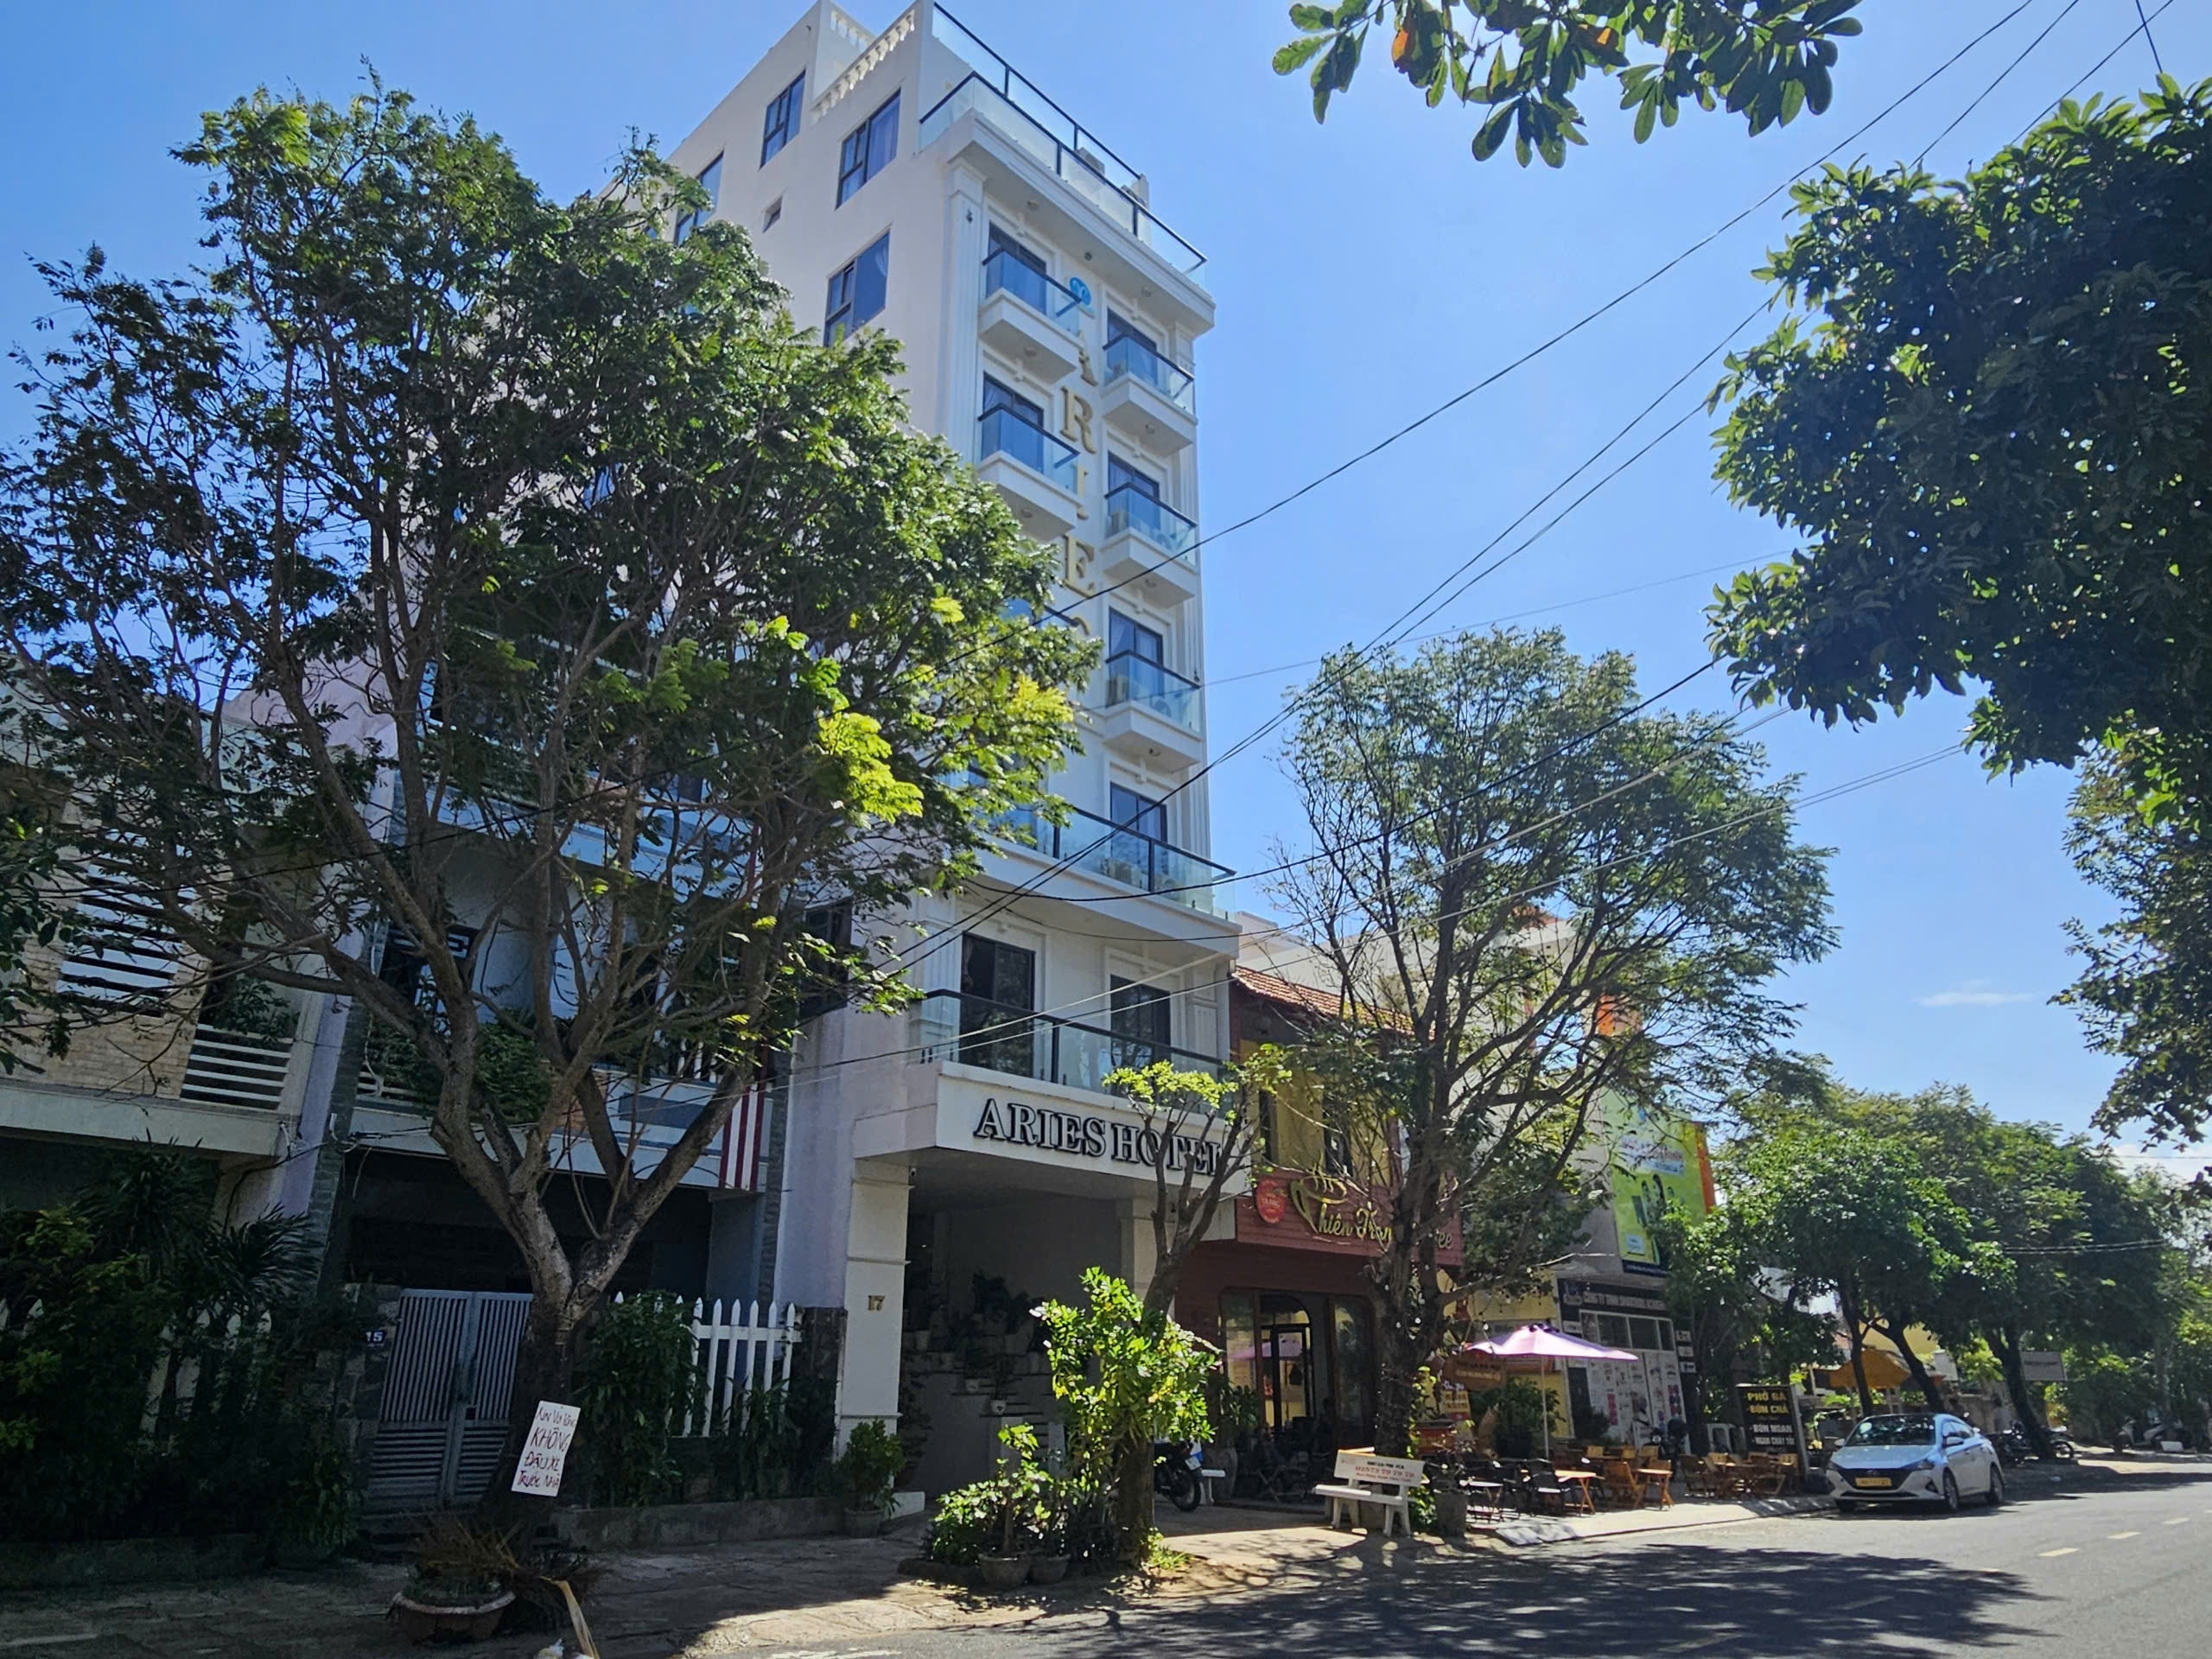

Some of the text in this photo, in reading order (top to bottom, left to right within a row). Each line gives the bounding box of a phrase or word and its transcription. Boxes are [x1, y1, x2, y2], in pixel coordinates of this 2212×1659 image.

[973, 1098, 1106, 1157] ARIES
[868, 1295, 886, 1311] 17
[365, 1332, 384, 1342] 15
[530, 1427, 571, 1452] KHÔNG
